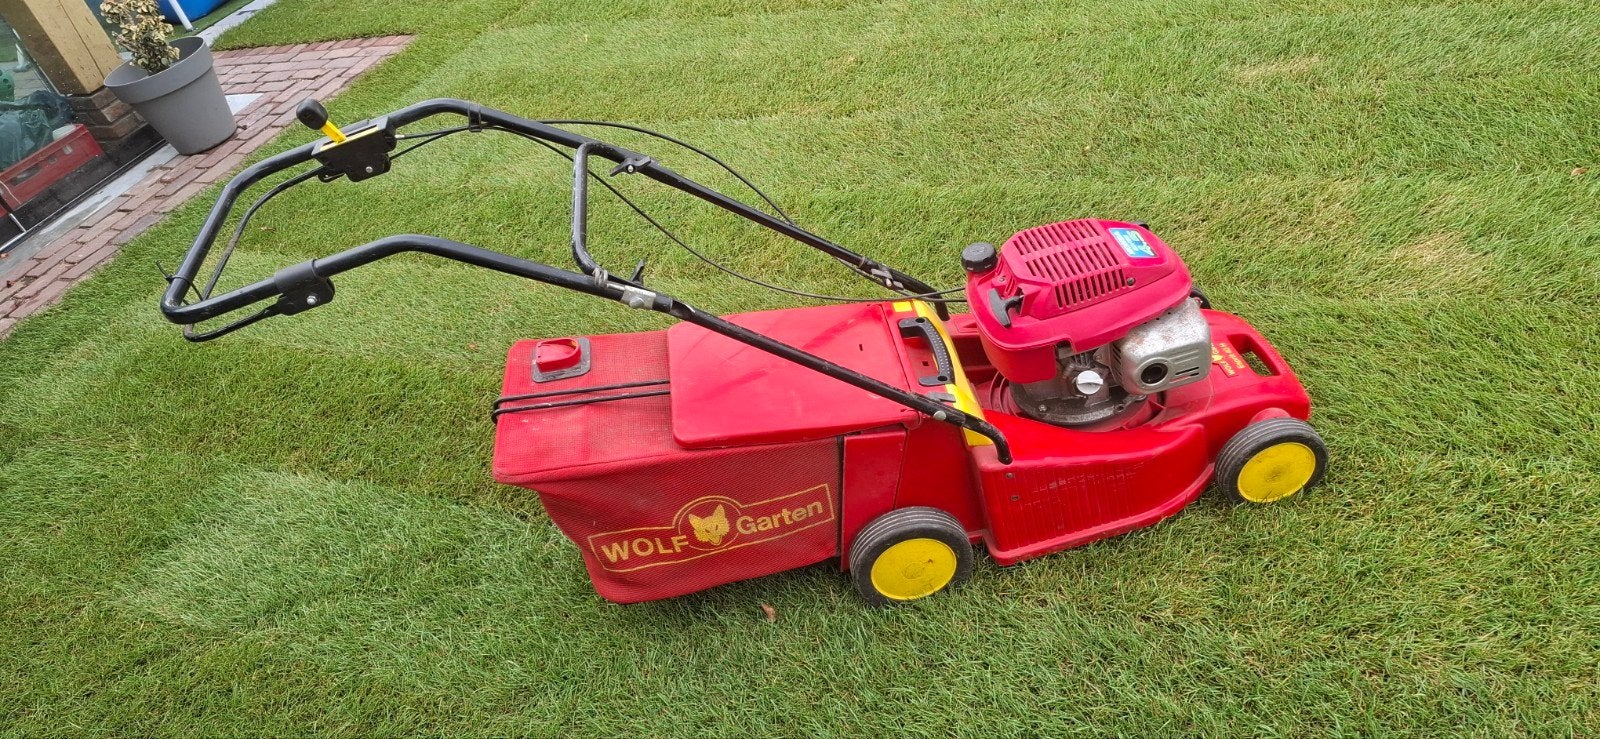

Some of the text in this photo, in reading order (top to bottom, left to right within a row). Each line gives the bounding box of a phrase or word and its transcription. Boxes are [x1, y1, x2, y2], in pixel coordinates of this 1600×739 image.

[1220, 361, 1236, 376] WOLF
[601, 501, 823, 563] WOLF Garten
